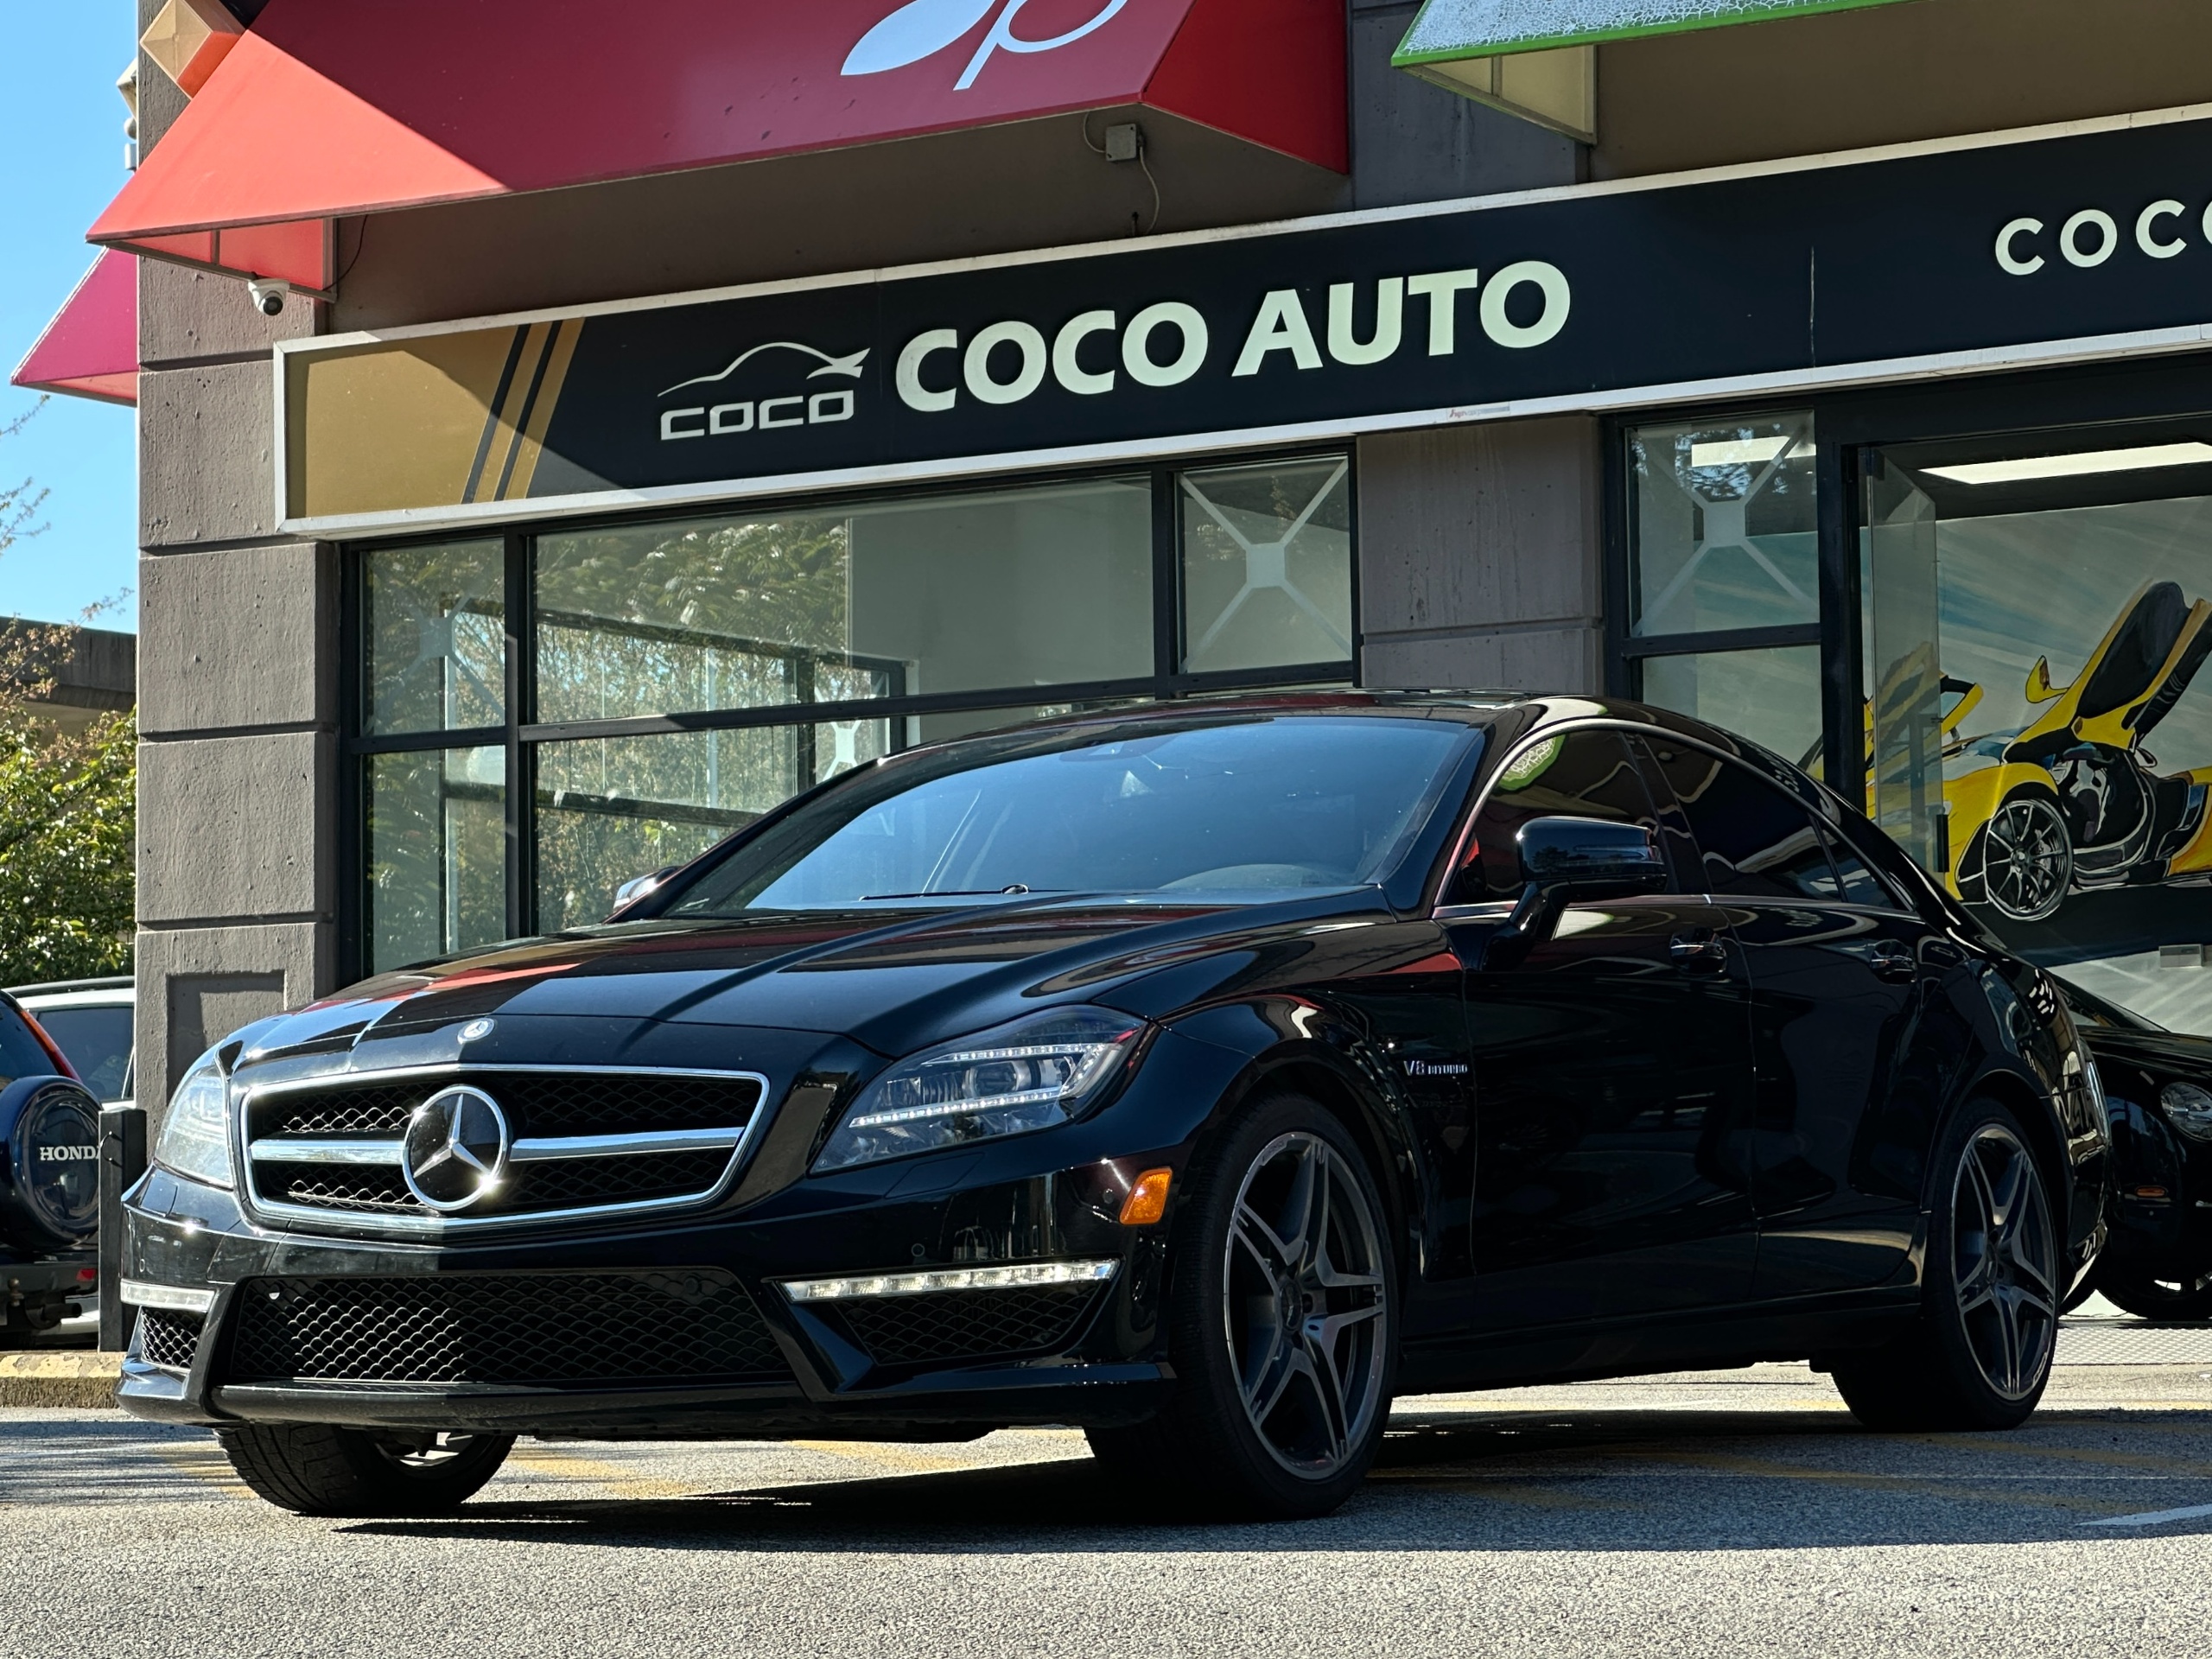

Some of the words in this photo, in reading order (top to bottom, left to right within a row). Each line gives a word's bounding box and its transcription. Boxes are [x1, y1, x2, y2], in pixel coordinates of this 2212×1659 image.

[1995, 199, 2212, 276] COC
[895, 302, 1209, 412] COCO
[1231, 260, 1571, 378] AUTO
[660, 390, 855, 441] COCO
[1403, 1060, 1425, 1077] V8
